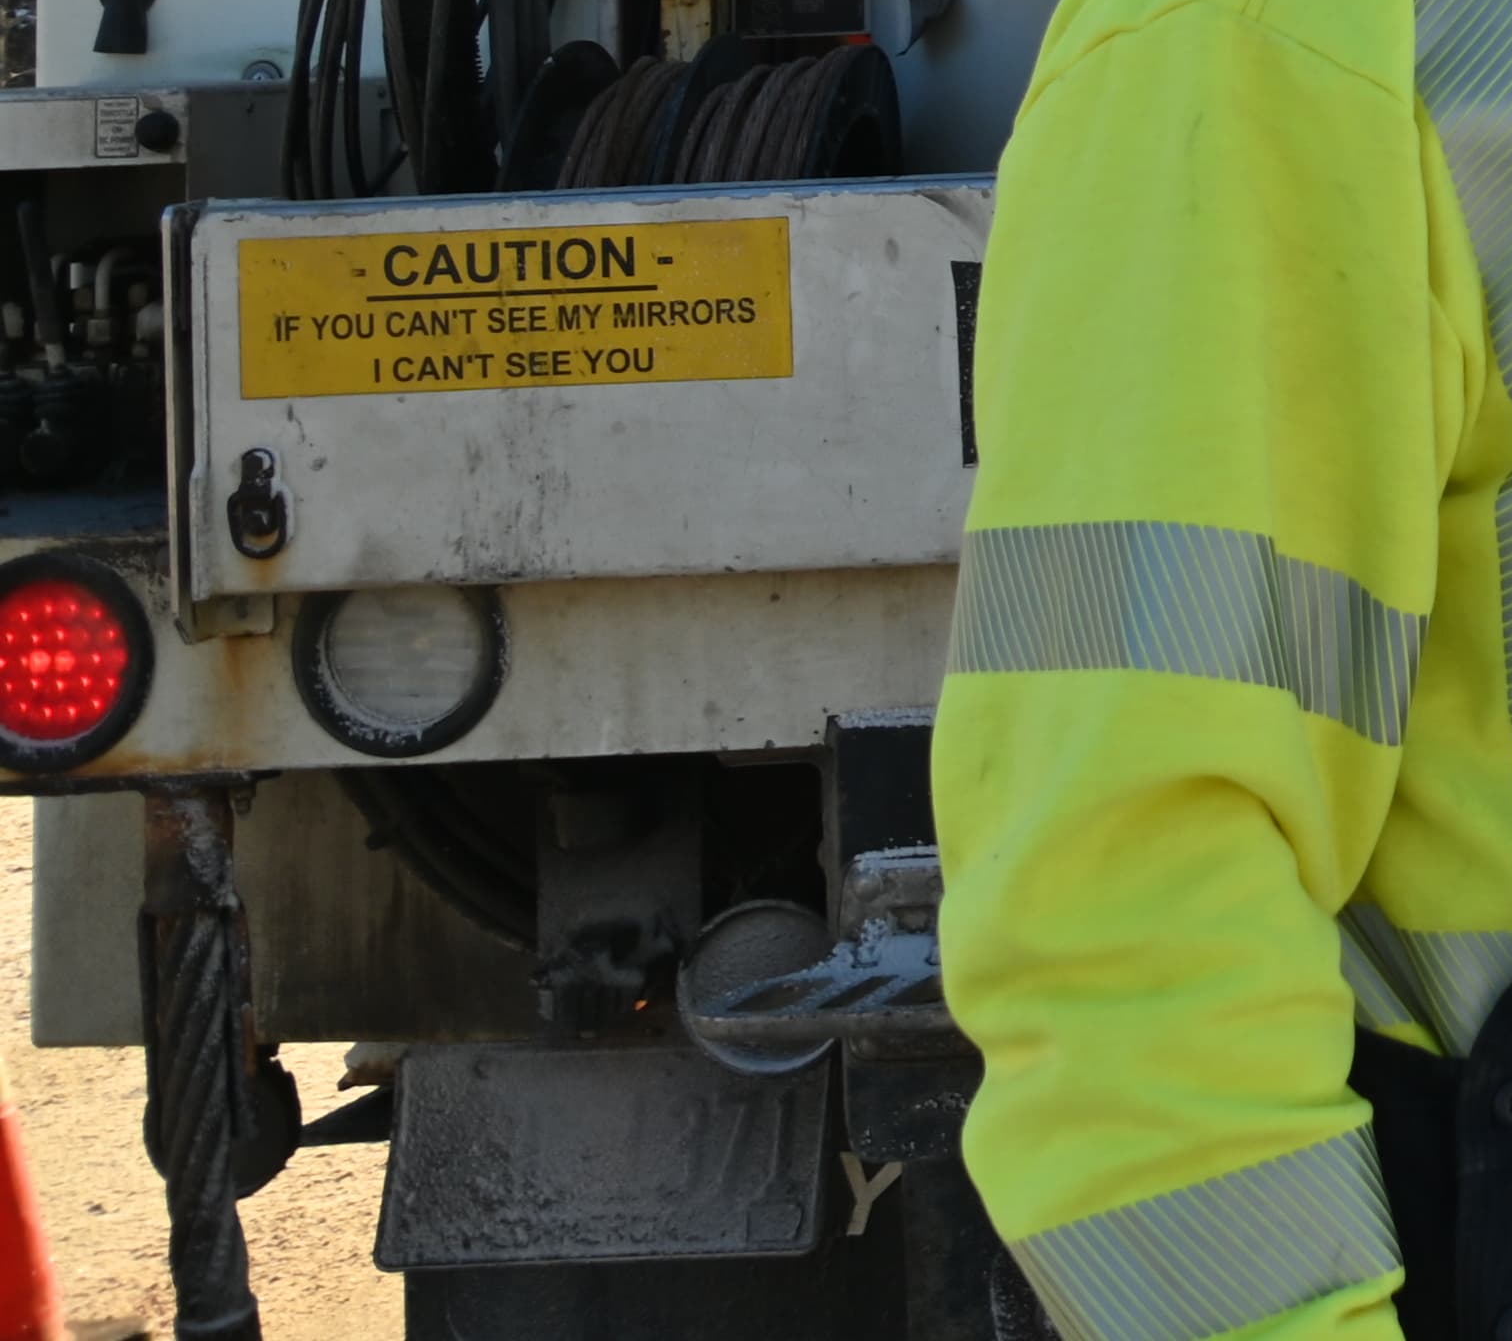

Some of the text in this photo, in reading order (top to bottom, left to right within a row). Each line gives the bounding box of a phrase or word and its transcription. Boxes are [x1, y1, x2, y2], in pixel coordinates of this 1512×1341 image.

[383, 236, 636, 287] CAUTION
[274, 297, 756, 342] IF YOU CAN'T SEE MY MIRRORS
[373, 347, 654, 383] I CAN'T SEE YOU
